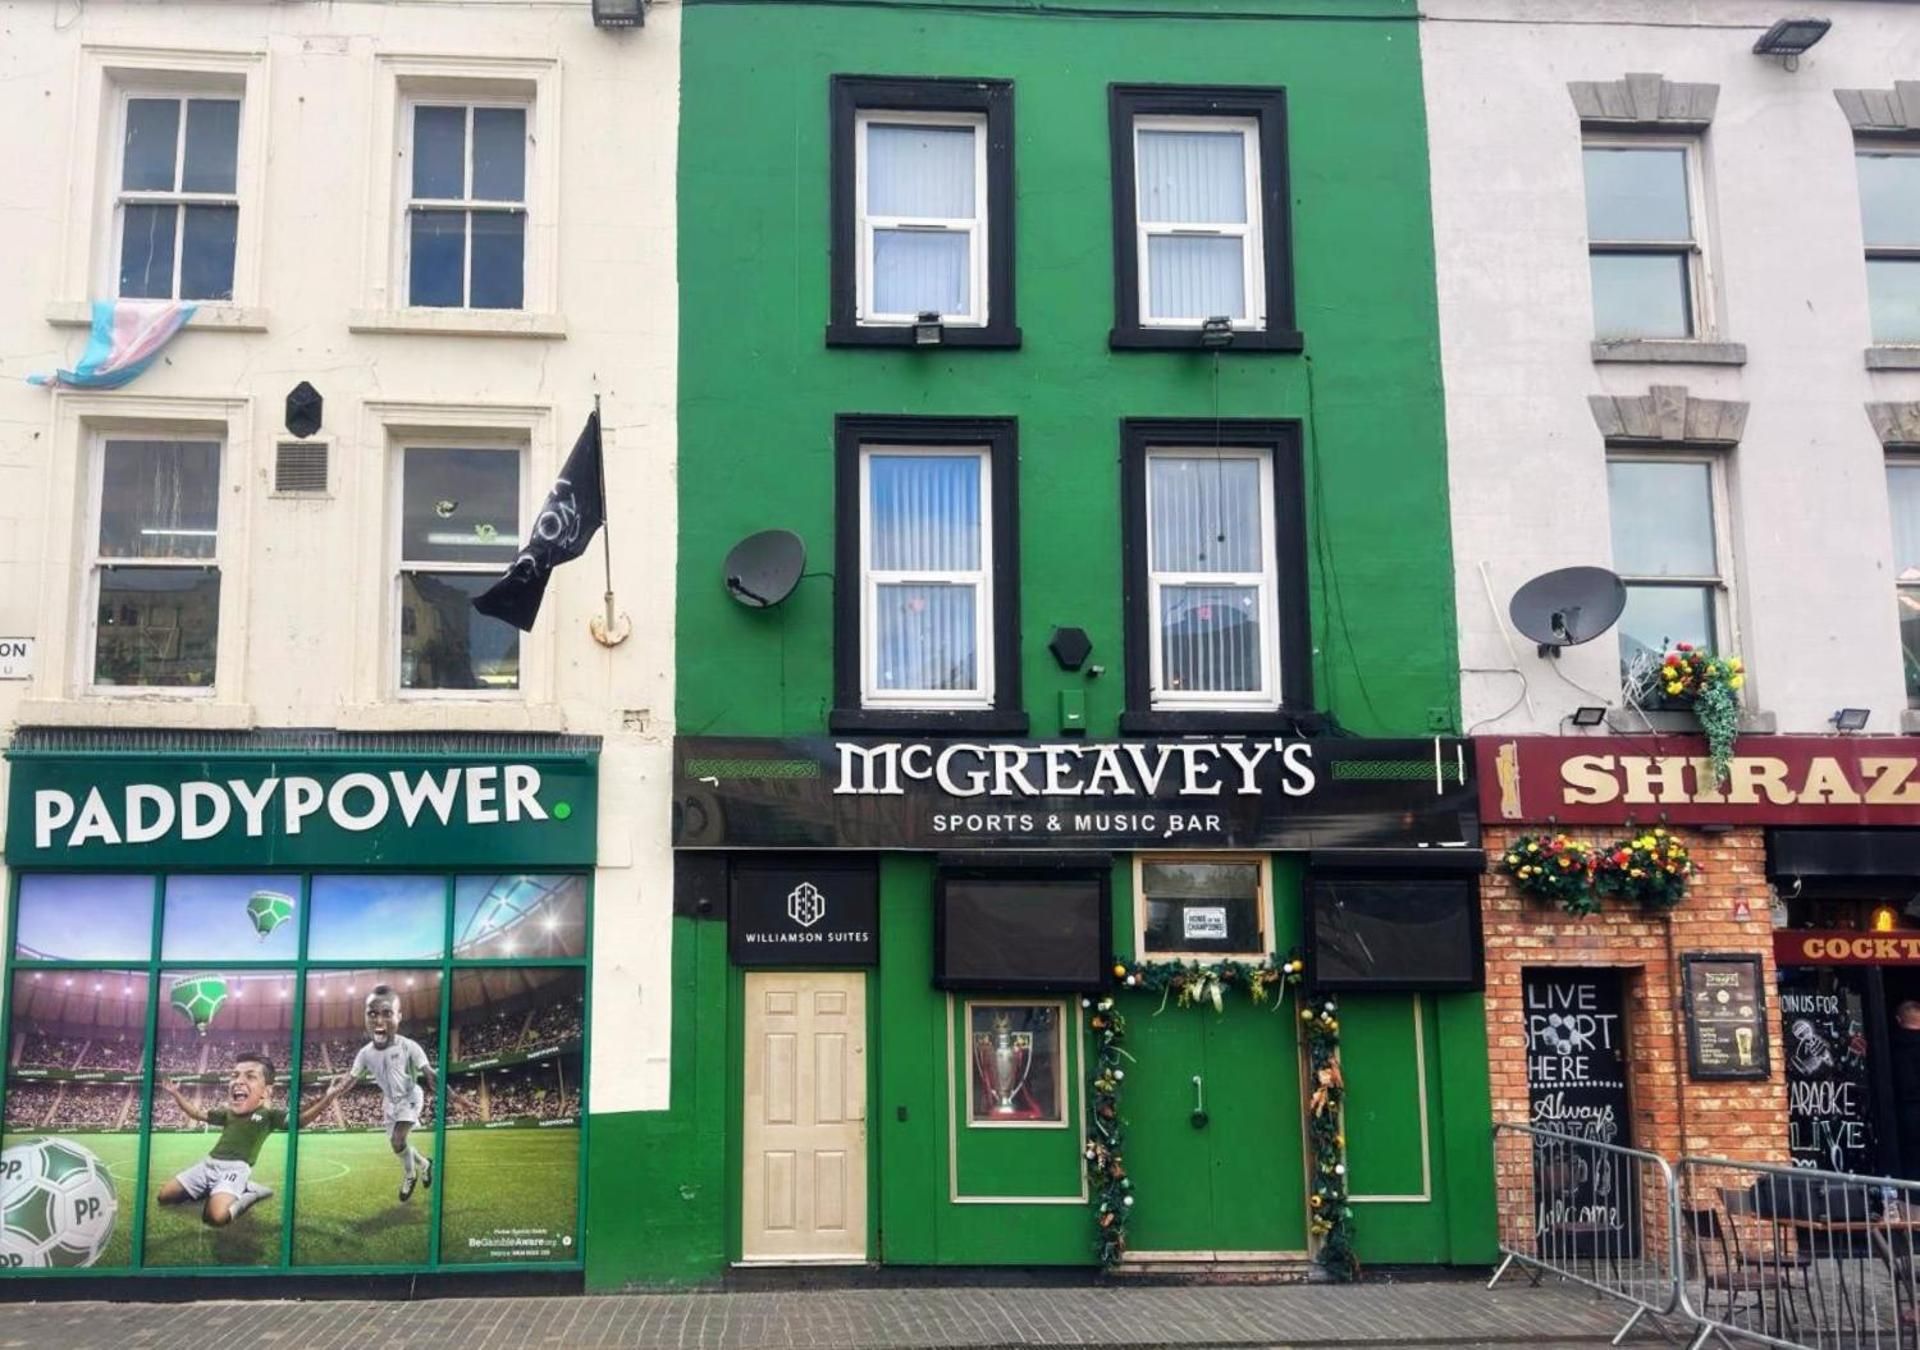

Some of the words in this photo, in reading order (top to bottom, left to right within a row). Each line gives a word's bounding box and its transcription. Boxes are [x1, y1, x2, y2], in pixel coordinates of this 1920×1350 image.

[933, 814, 1034, 832] SPORTS
[1047, 814, 1062, 831] &
[1075, 813, 1156, 831] MUSIC
[1169, 812, 1221, 831] BAR
[746, 933, 822, 943] WILLIAMSON
[828, 932, 869, 942] SUITES
[1528, 984, 1597, 1010] LIVE
[1815, 995, 1839, 1014] FOR
[1523, 1013, 1618, 1055] PORT
[1529, 1056, 1589, 1080] HERE
[1787, 1080, 1856, 1116] ARAOKE
[1529, 1091, 1615, 1133] Always
